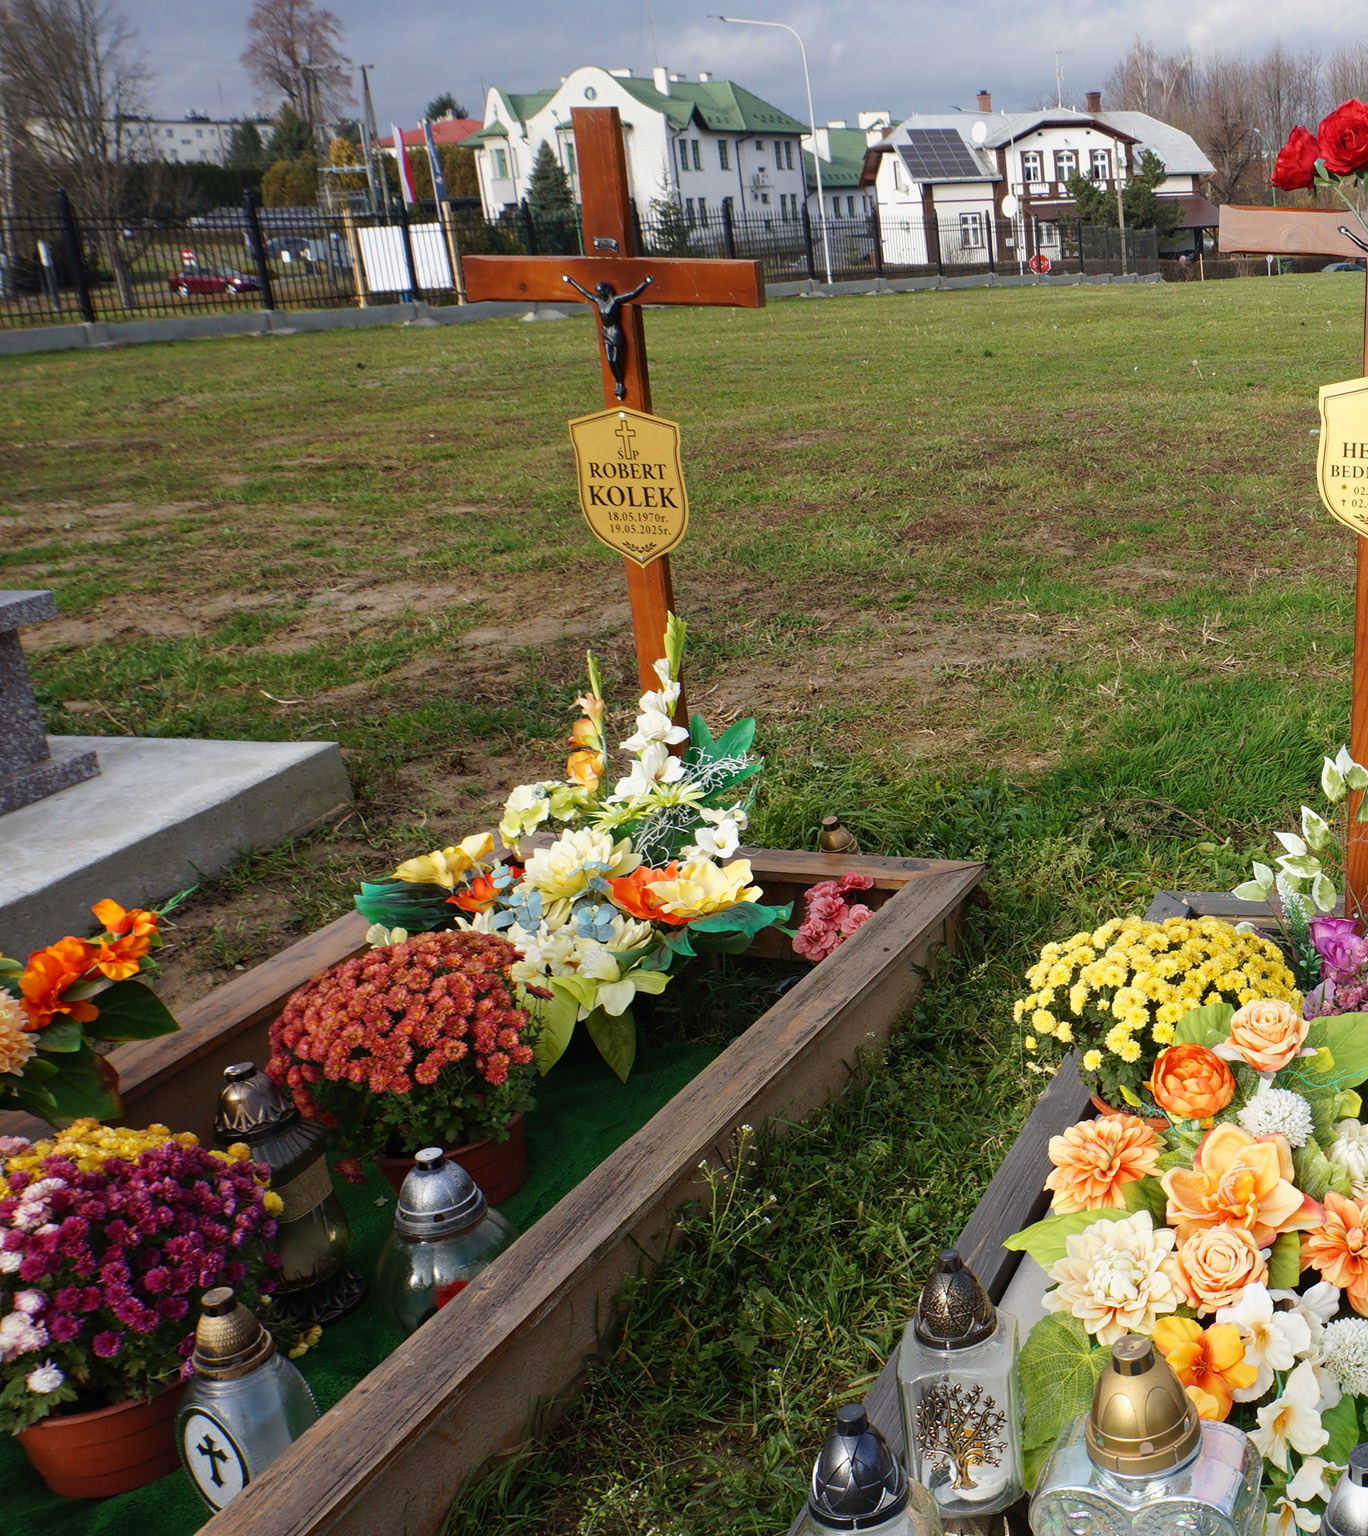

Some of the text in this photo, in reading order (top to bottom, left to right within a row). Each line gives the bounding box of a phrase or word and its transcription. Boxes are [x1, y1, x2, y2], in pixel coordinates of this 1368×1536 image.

[588, 462, 667, 480] ROBERT
[588, 485, 679, 509] KOLEK
[607, 511, 669, 523] 18.05.1970r.
[609, 524, 672, 536] 19.05.2025r.
